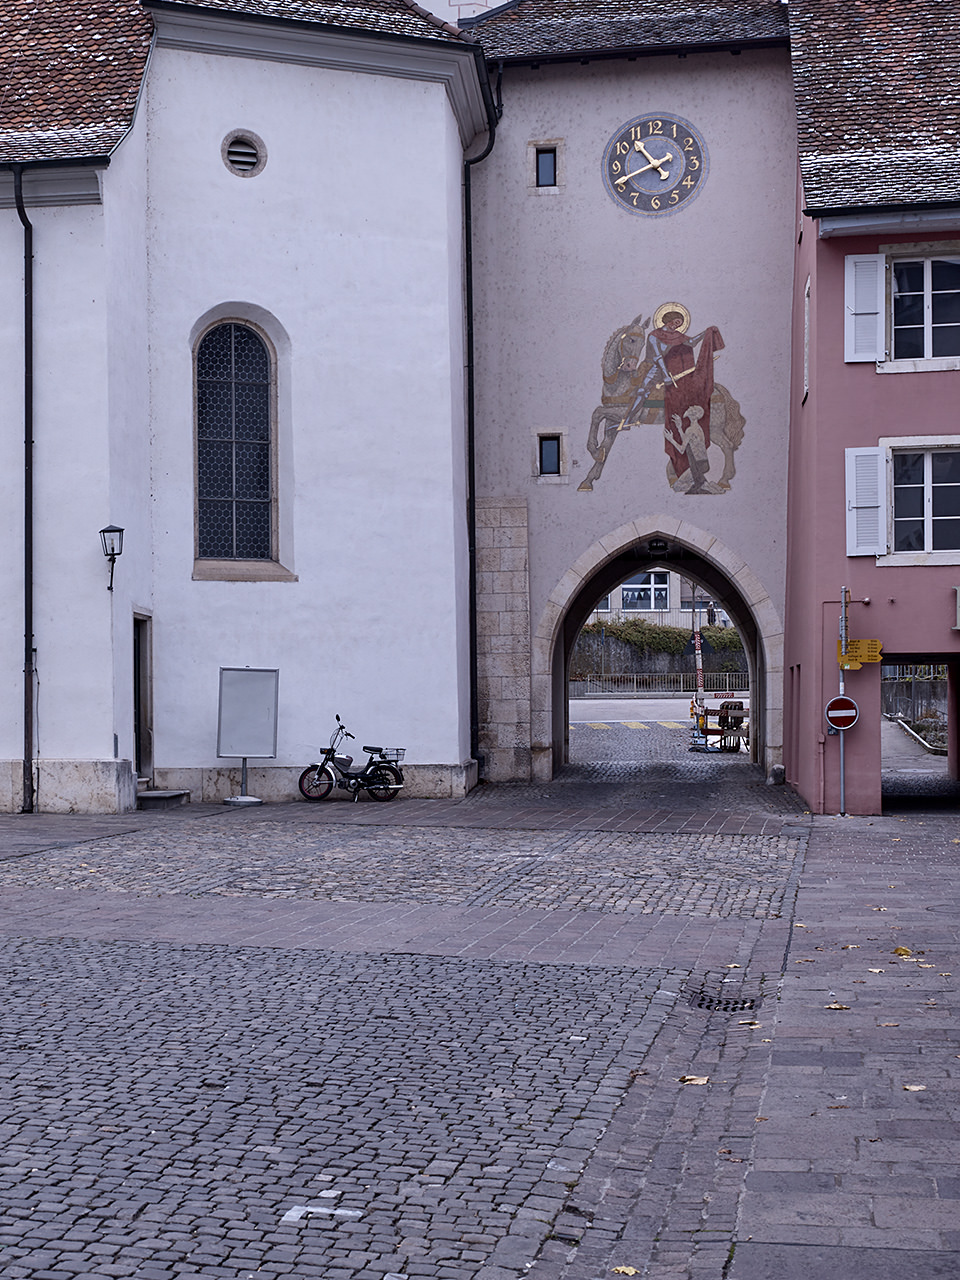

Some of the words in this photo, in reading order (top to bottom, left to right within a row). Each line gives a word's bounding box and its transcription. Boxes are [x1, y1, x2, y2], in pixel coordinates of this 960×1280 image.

[629, 126, 641, 140] 11
[647, 120, 663, 135] 12
[671, 123, 677, 138] 1
[615, 141, 630, 155] 10
[683, 137, 694, 151] 2
[612, 160, 621, 175] 9
[688, 156, 700, 171] 3
[681, 175, 695, 189] 4
[629, 192, 640, 206] 7
[650, 195, 661, 210] 6
[668, 190, 680, 205] 5
